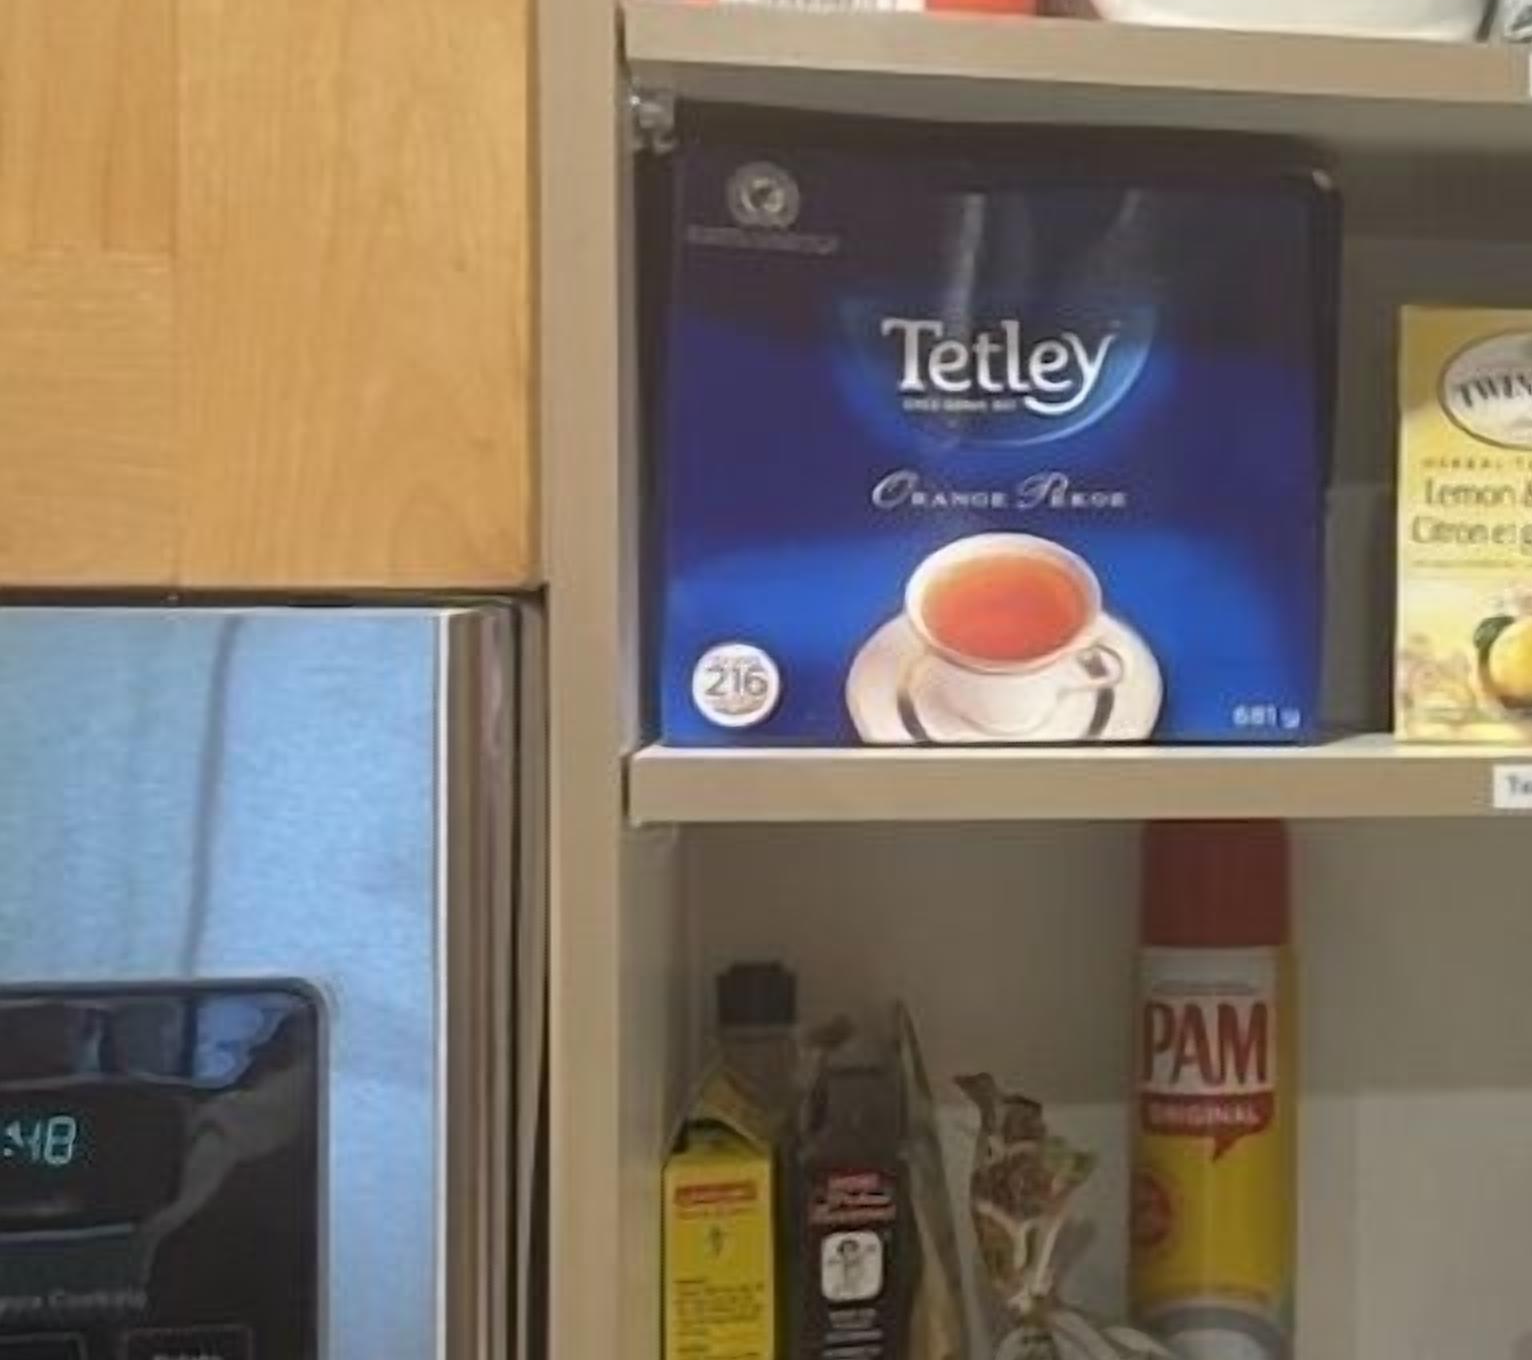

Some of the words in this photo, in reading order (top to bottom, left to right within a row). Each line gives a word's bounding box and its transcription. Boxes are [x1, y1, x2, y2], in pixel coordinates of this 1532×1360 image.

[881, 317, 1118, 415] Tetley
[1424, 478, 1517, 507] Lemon
[1411, 516, 1489, 544] Citron
[703, 664, 769, 697] 216
[1144, 1000, 1268, 1086] PAM
